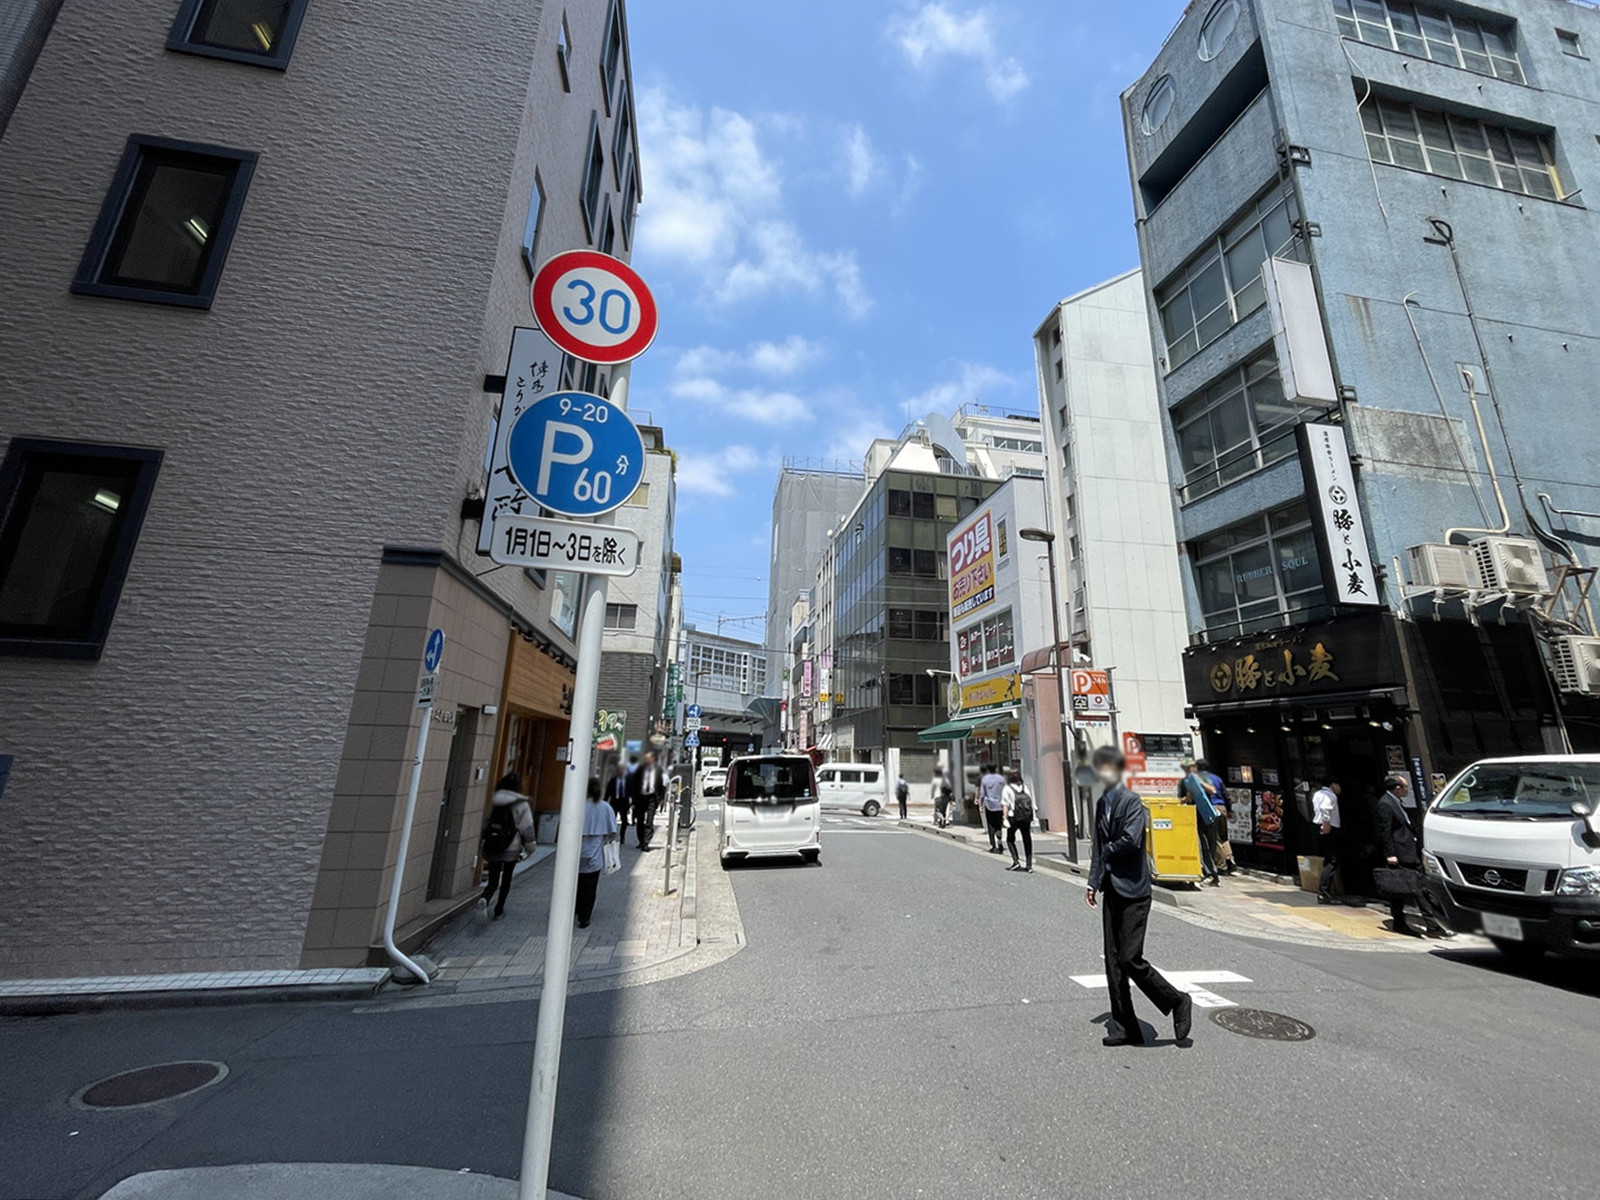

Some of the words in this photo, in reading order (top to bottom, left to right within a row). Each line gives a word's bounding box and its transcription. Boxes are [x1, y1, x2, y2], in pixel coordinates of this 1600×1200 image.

[563, 279, 631, 334] 30
[559, 398, 608, 423] 9-20
[536, 420, 593, 496] P
[573, 468, 613, 504] 60
[615, 454, 629, 476] 分
[952, 516, 990, 572] つり具
[1236, 565, 1273, 583] RUBBER
[1282, 555, 1309, 571] SOUL
[1333, 509, 1369, 597] 豚と小麦
[985, 622, 1004, 636] コーナー
[1235, 642, 1340, 693] 豚と小麦
[1073, 694, 1088, 710] 空
